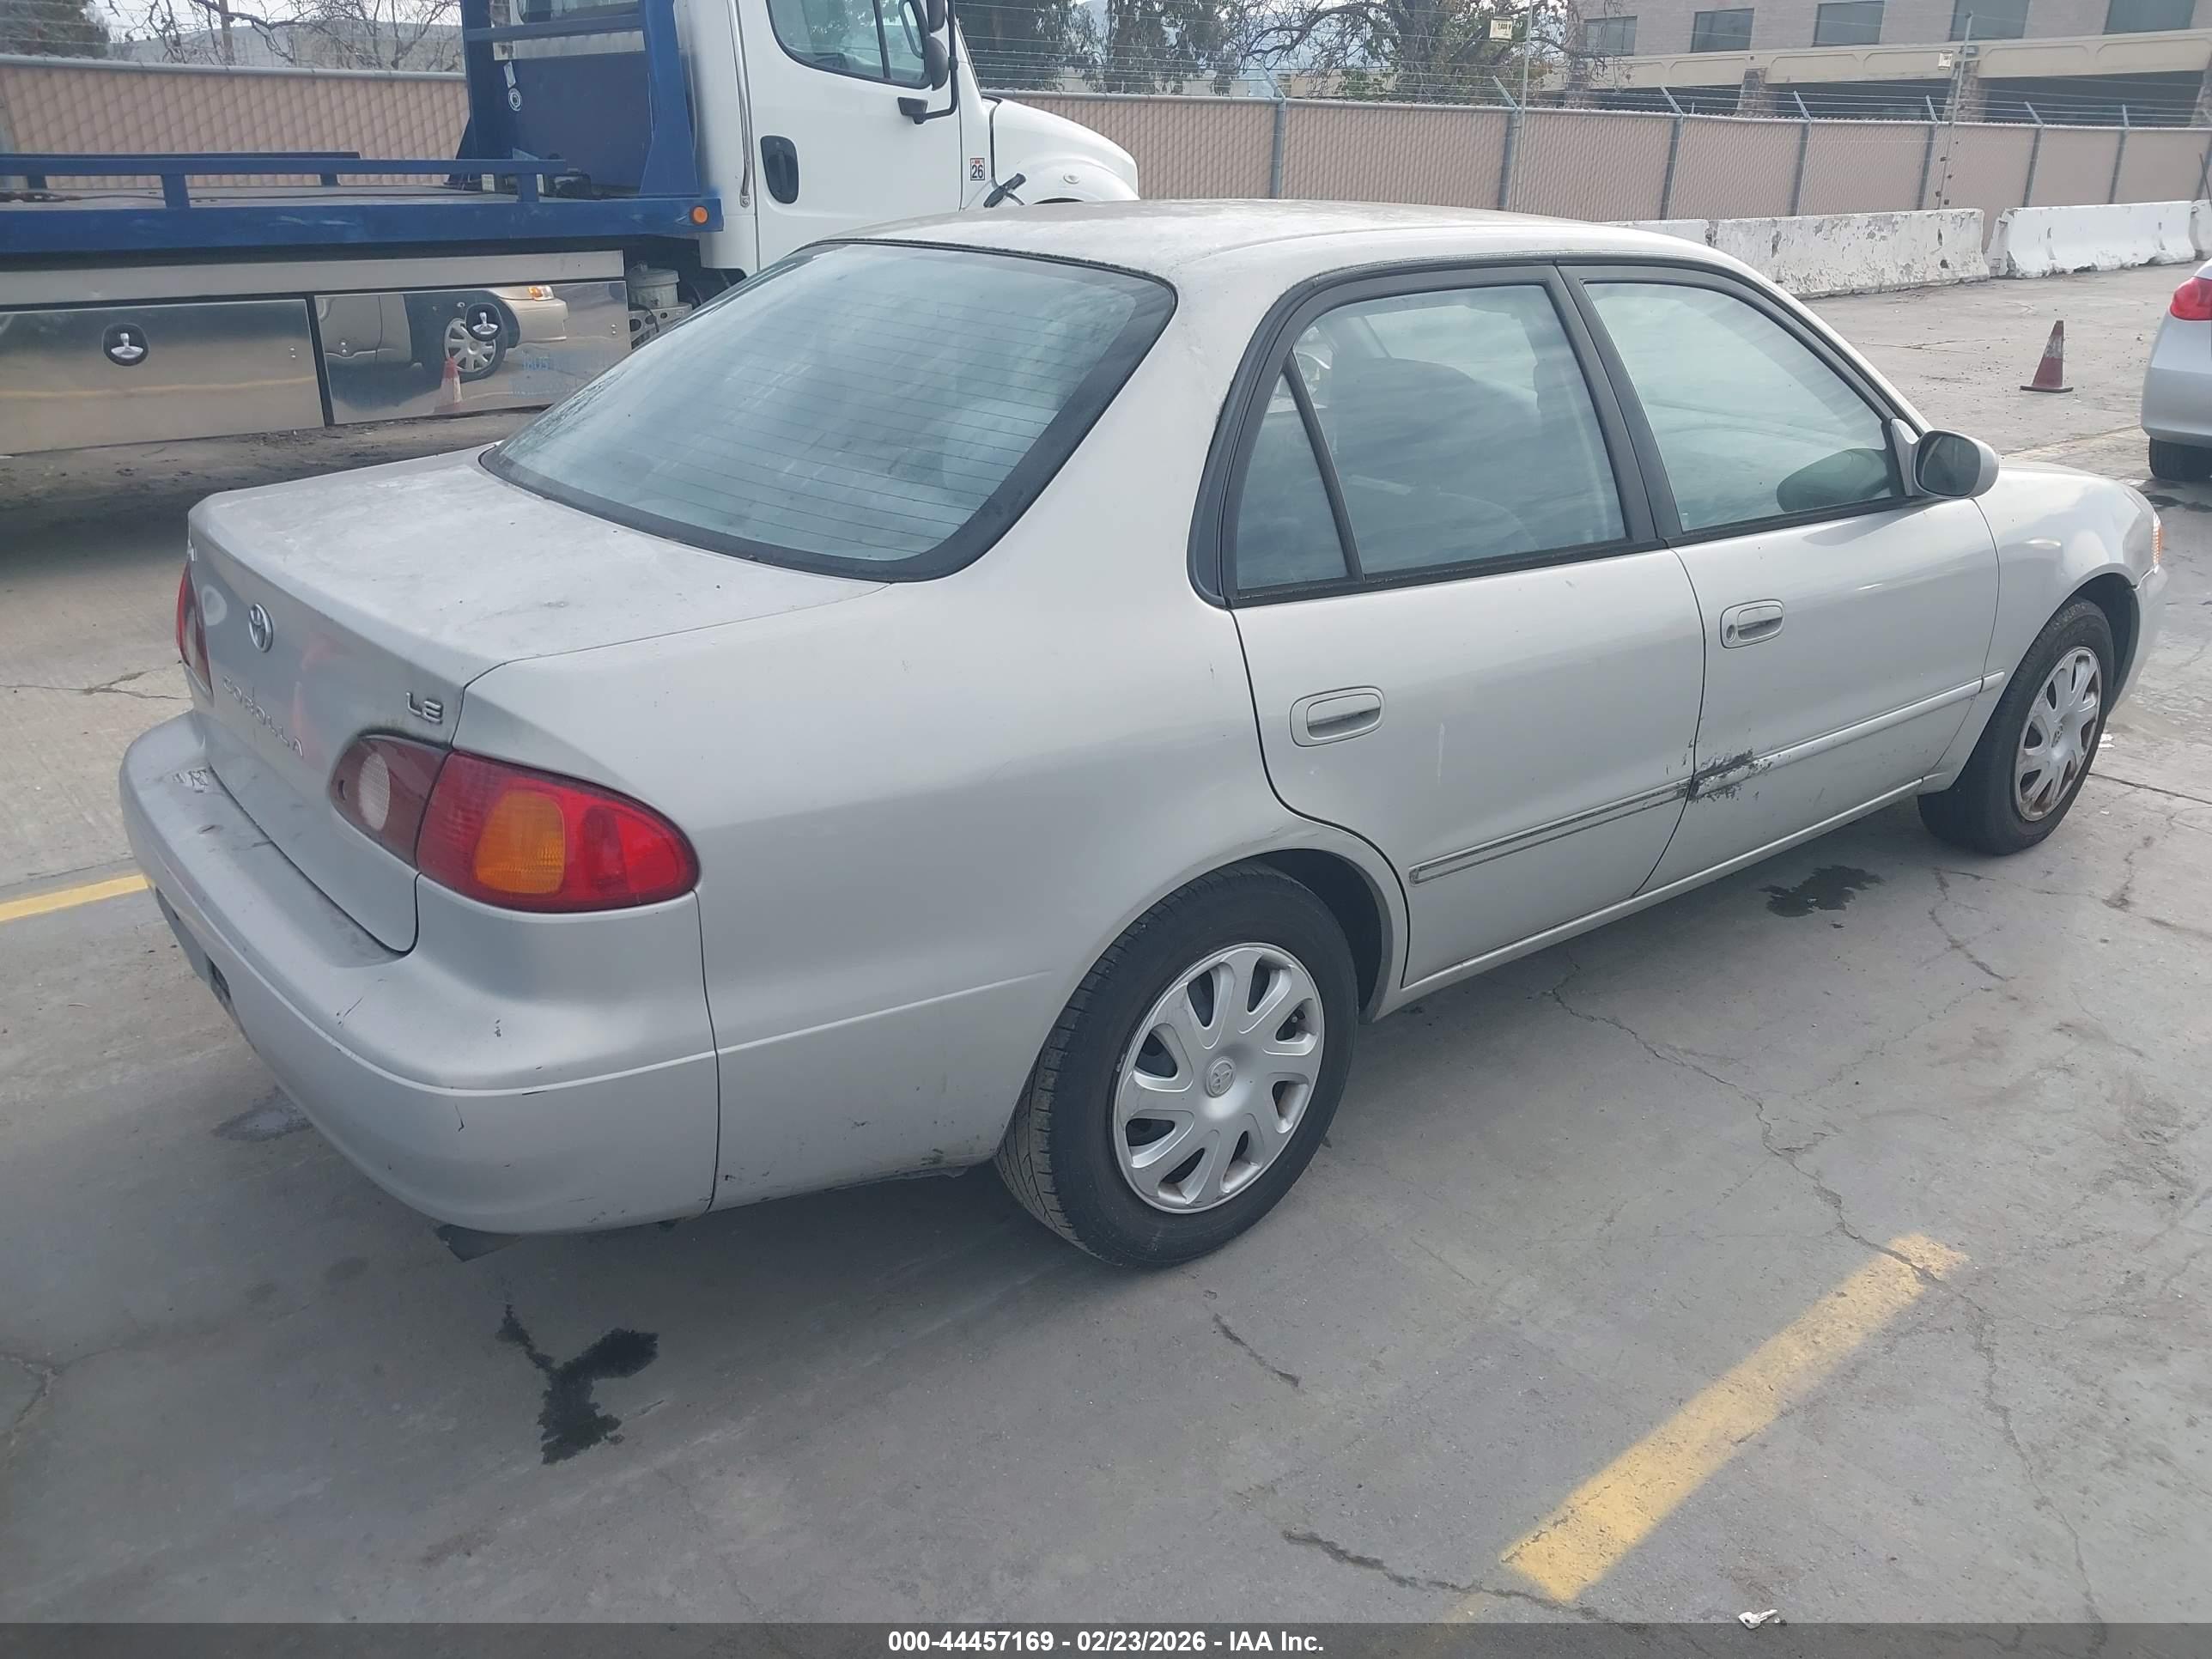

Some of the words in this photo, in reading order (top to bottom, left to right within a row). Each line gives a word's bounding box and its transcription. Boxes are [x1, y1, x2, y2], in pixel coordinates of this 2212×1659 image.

[971, 164, 984, 179] 26
[222, 674, 305, 759] COROLLA
[405, 690, 444, 726] LE
